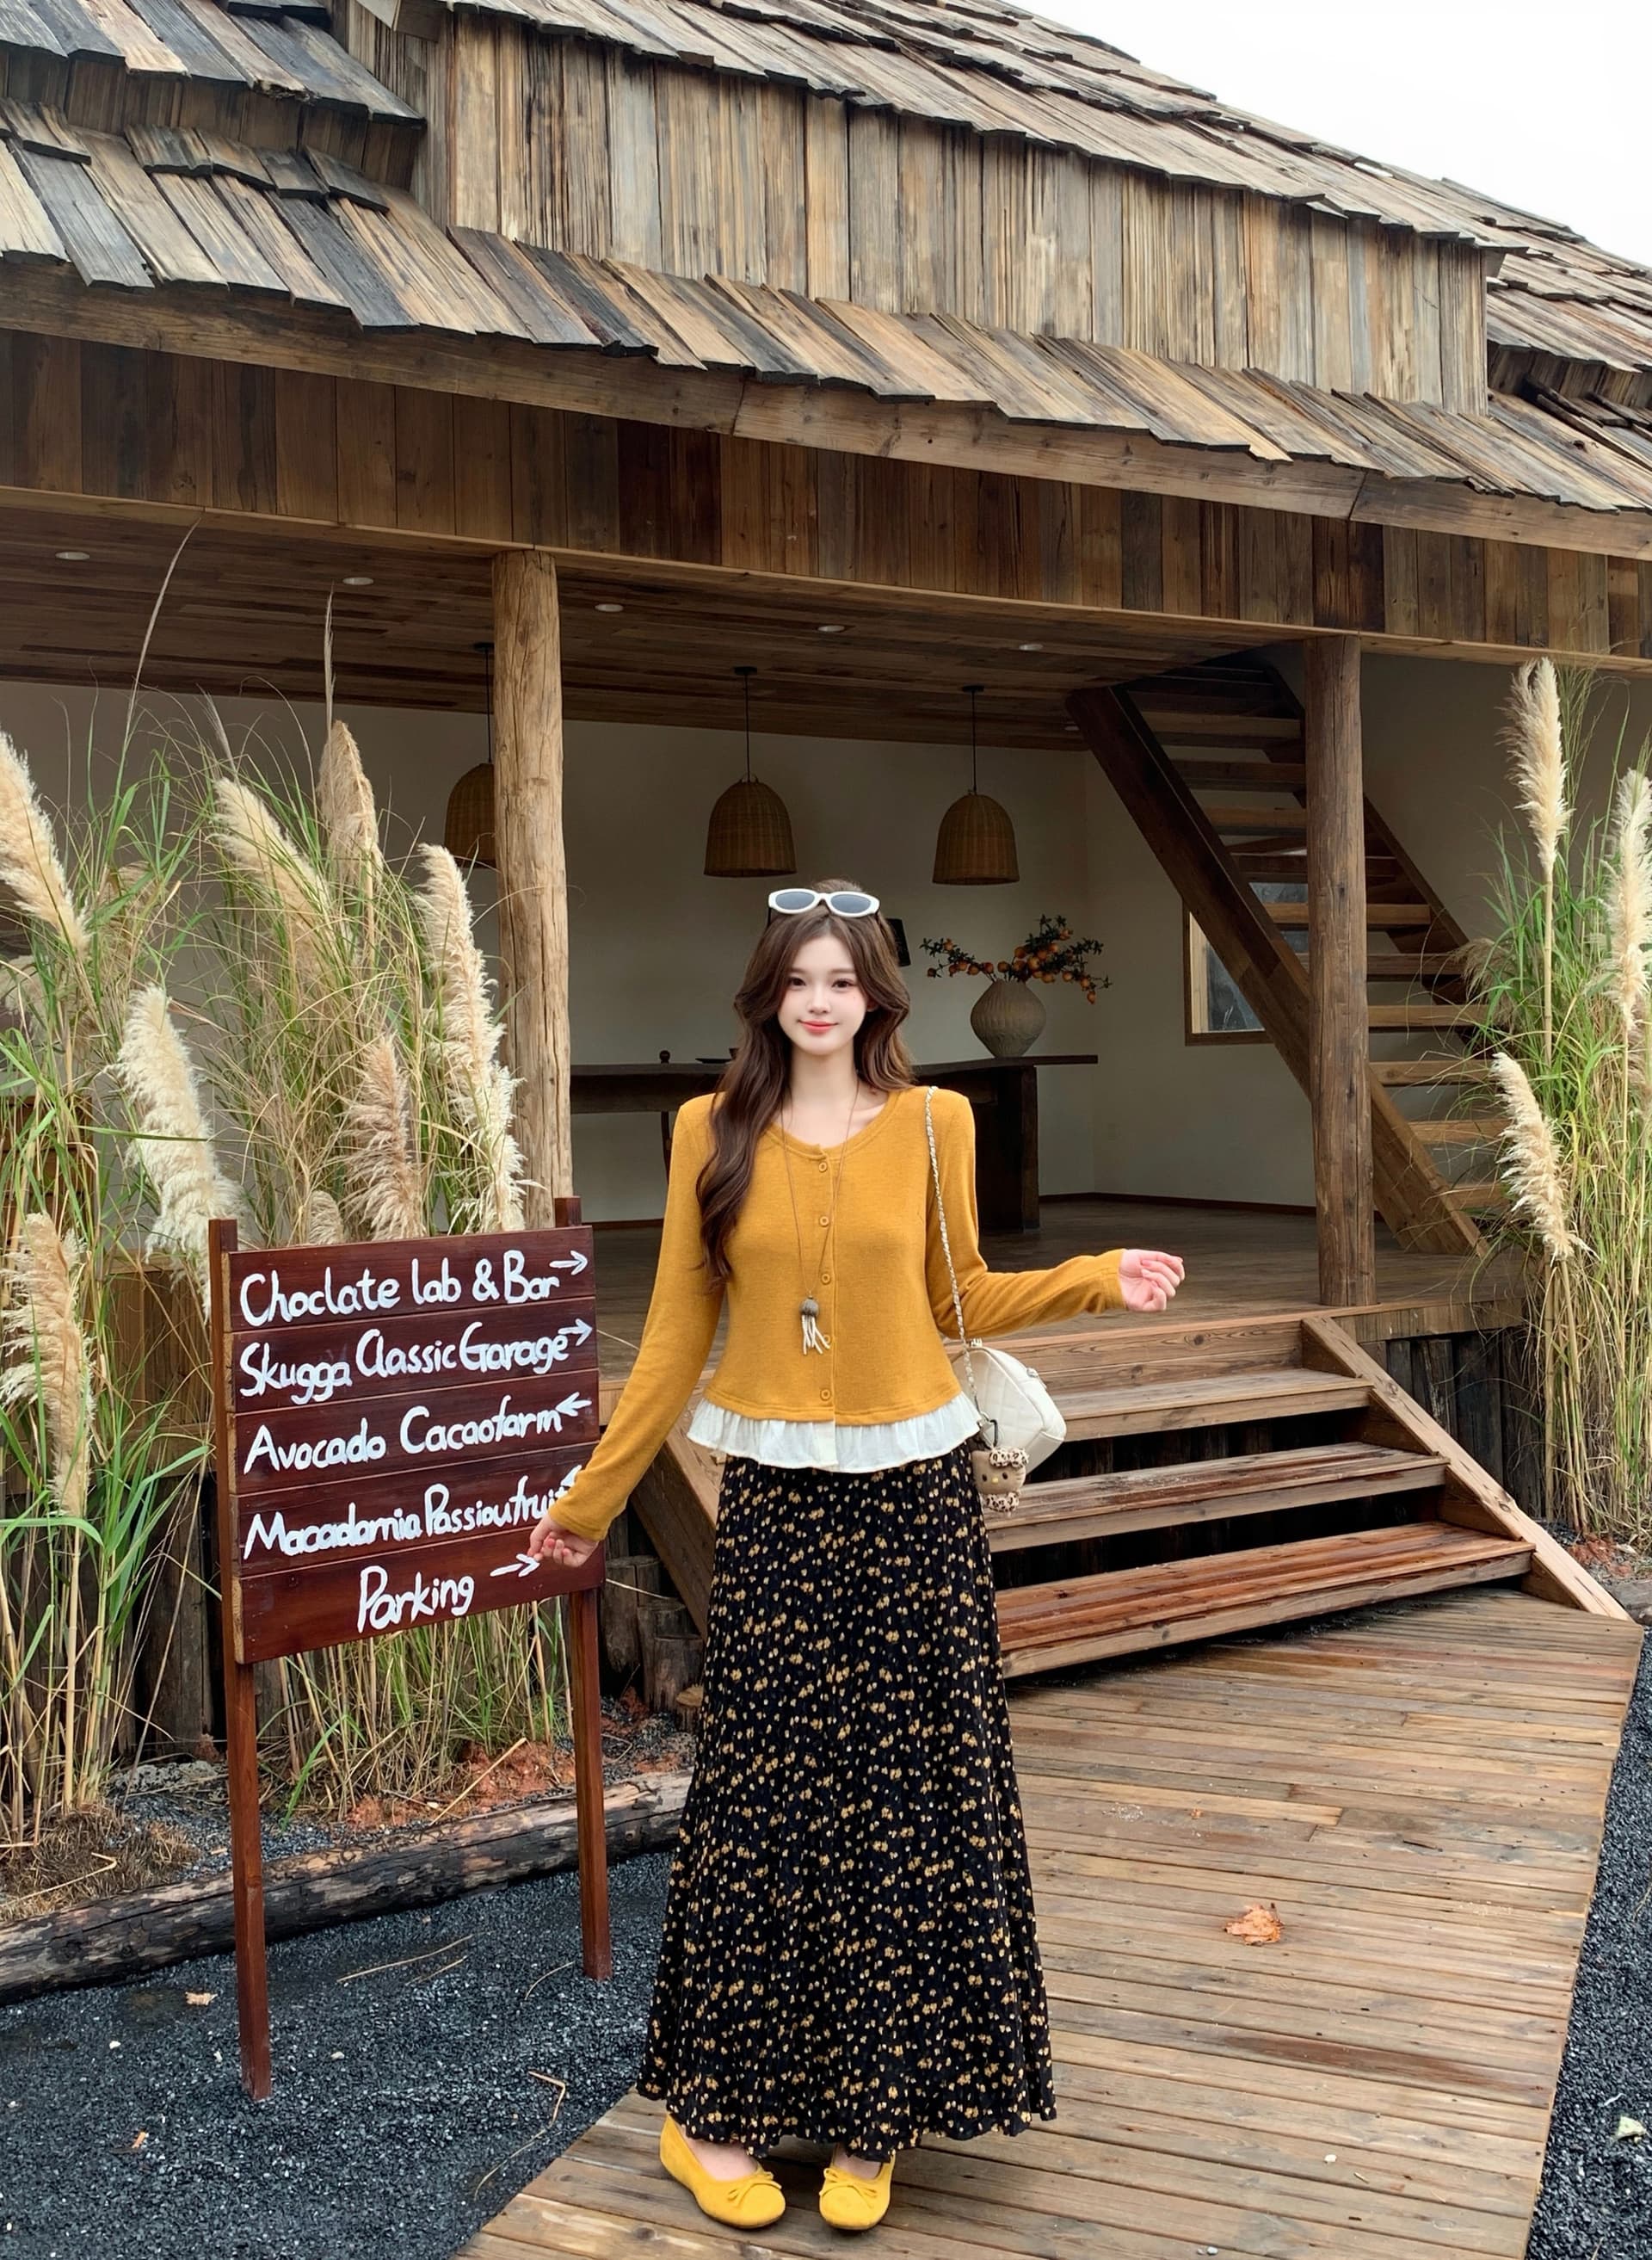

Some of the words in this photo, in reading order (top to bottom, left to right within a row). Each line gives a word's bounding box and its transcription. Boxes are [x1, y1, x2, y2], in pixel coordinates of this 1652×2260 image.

[239, 1266, 401, 1327] Choclate
[472, 1258, 500, 1302] &
[503, 1250, 560, 1304] Bar
[239, 1342, 354, 1405] Skugga
[355, 1328, 459, 1378] Classic
[459, 1321, 570, 1374] Garage
[243, 1417, 387, 1475] Avocado
[243, 1502, 423, 1560] Macadamia
[357, 1565, 475, 1633] Parking
